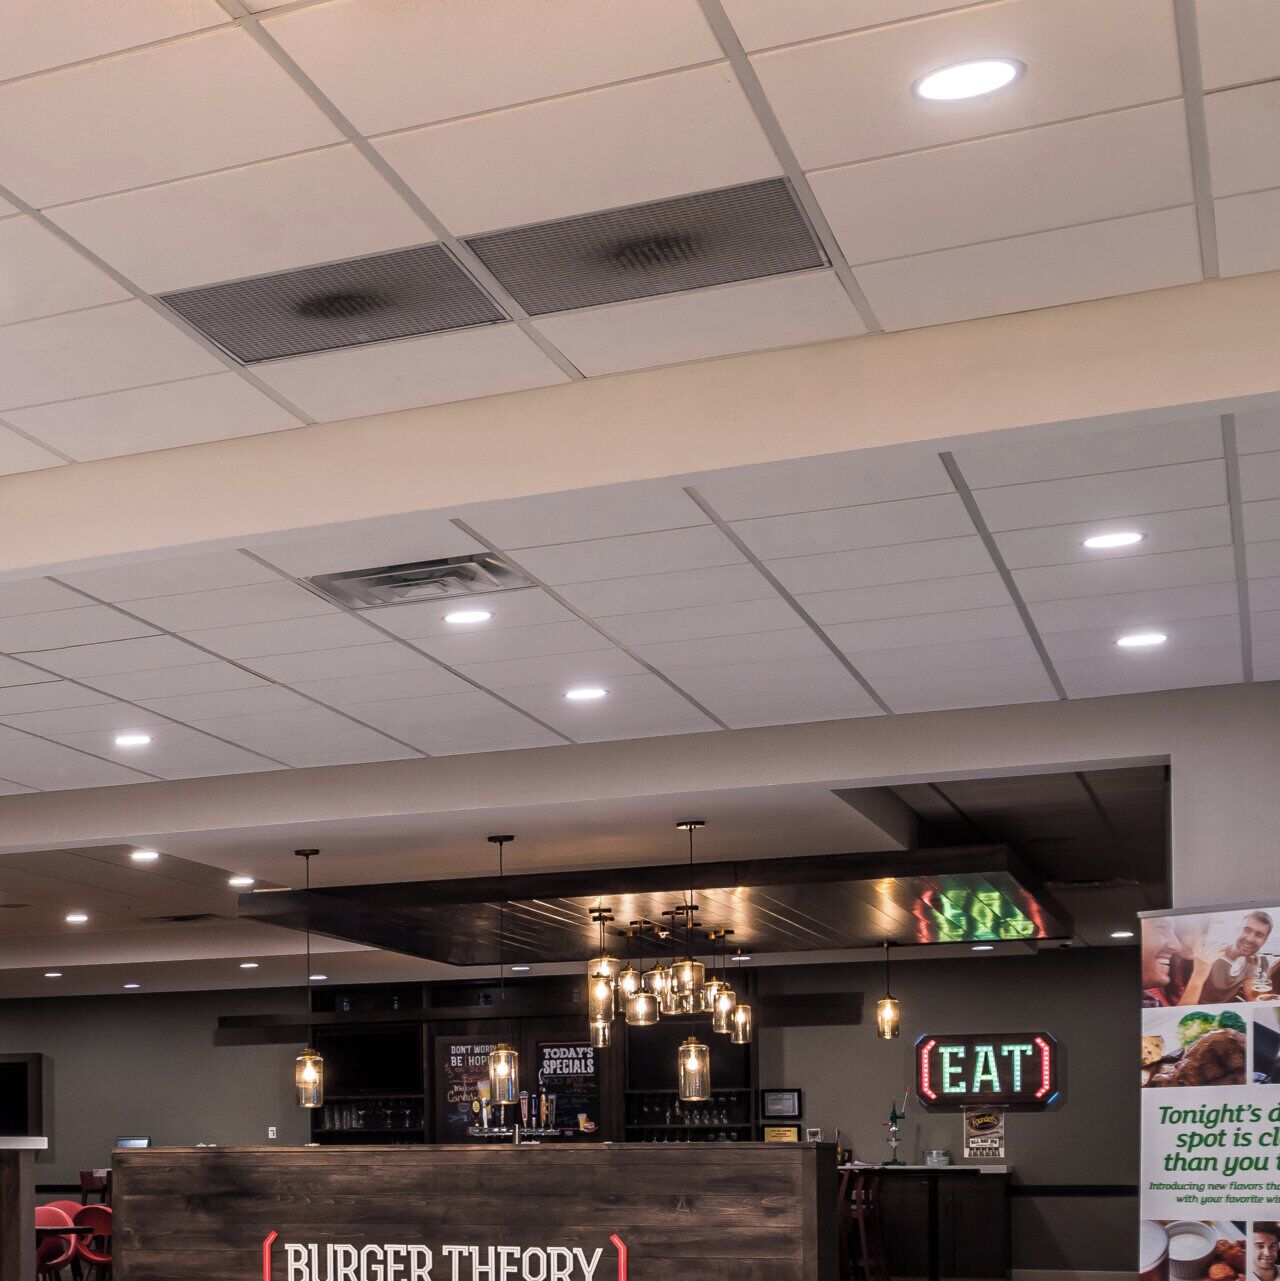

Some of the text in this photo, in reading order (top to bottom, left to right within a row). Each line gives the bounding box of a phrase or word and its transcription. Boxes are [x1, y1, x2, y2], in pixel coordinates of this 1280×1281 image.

[543, 1047, 594, 1059] TODAY'S
[451, 1056, 463, 1067] BE
[543, 1059, 594, 1074] SPECIALS
[1159, 1103, 1262, 1129] Tonight's
[1176, 1129, 1227, 1153] spot
[1233, 1127, 1253, 1147] is
[1164, 1152, 1218, 1171] than
[1222, 1156, 1269, 1176] you
[1149, 1182, 1205, 1192] Introducing
[1229, 1181, 1263, 1190] flavors
[1176, 1195, 1198, 1203] with
[1200, 1196, 1222, 1205] your
[1225, 1194, 1264, 1204] favorite
